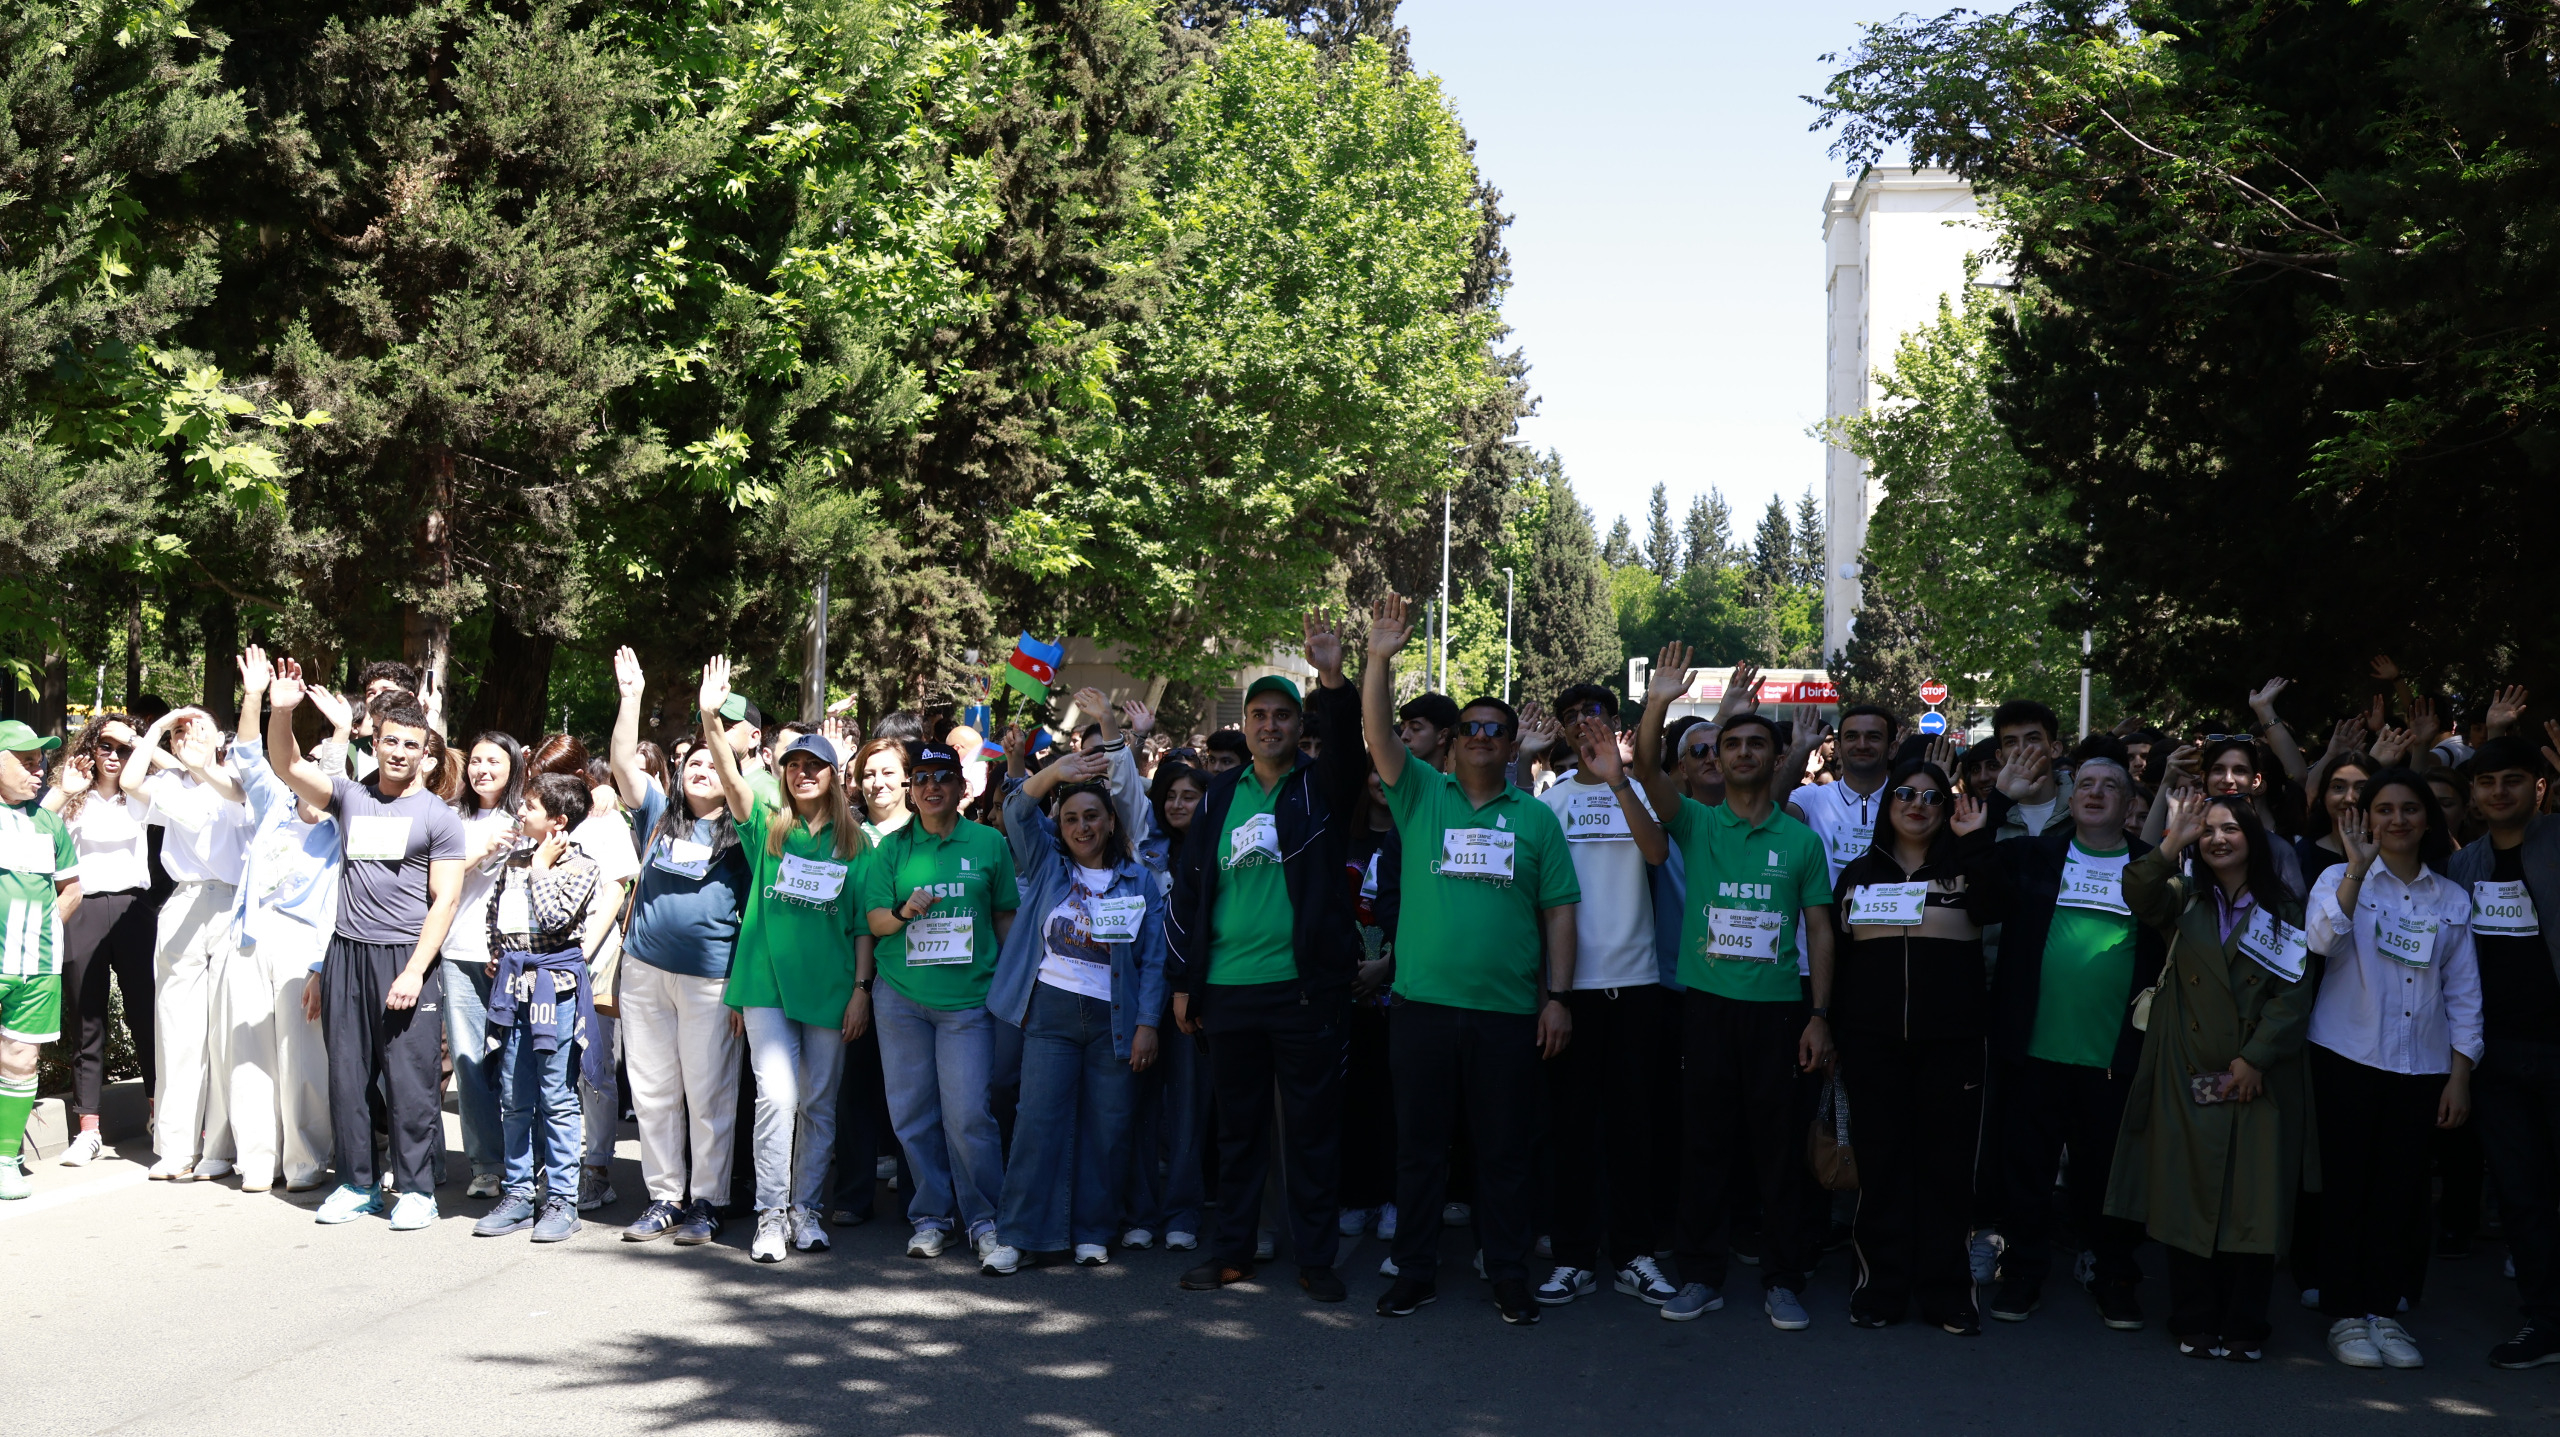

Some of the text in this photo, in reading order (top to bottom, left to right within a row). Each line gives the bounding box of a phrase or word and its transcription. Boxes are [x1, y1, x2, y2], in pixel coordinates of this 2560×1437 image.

[1921, 687, 1945, 696] STOP
[1578, 813, 1610, 826] 0050
[1454, 852, 1488, 865] 0111
[788, 877, 820, 892] 1983
[1718, 881, 1772, 900] MSU
[2073, 881, 2109, 896] 1554
[1863, 901, 1898, 913] 1555
[2485, 904, 2523, 918] 0400
[1095, 915, 1127, 927] 0582
[917, 940, 950, 953] 0777
[1718, 933, 1753, 949] 0045
[2251, 929, 2284, 956] 1636
[2384, 931, 2421, 953] 1569
